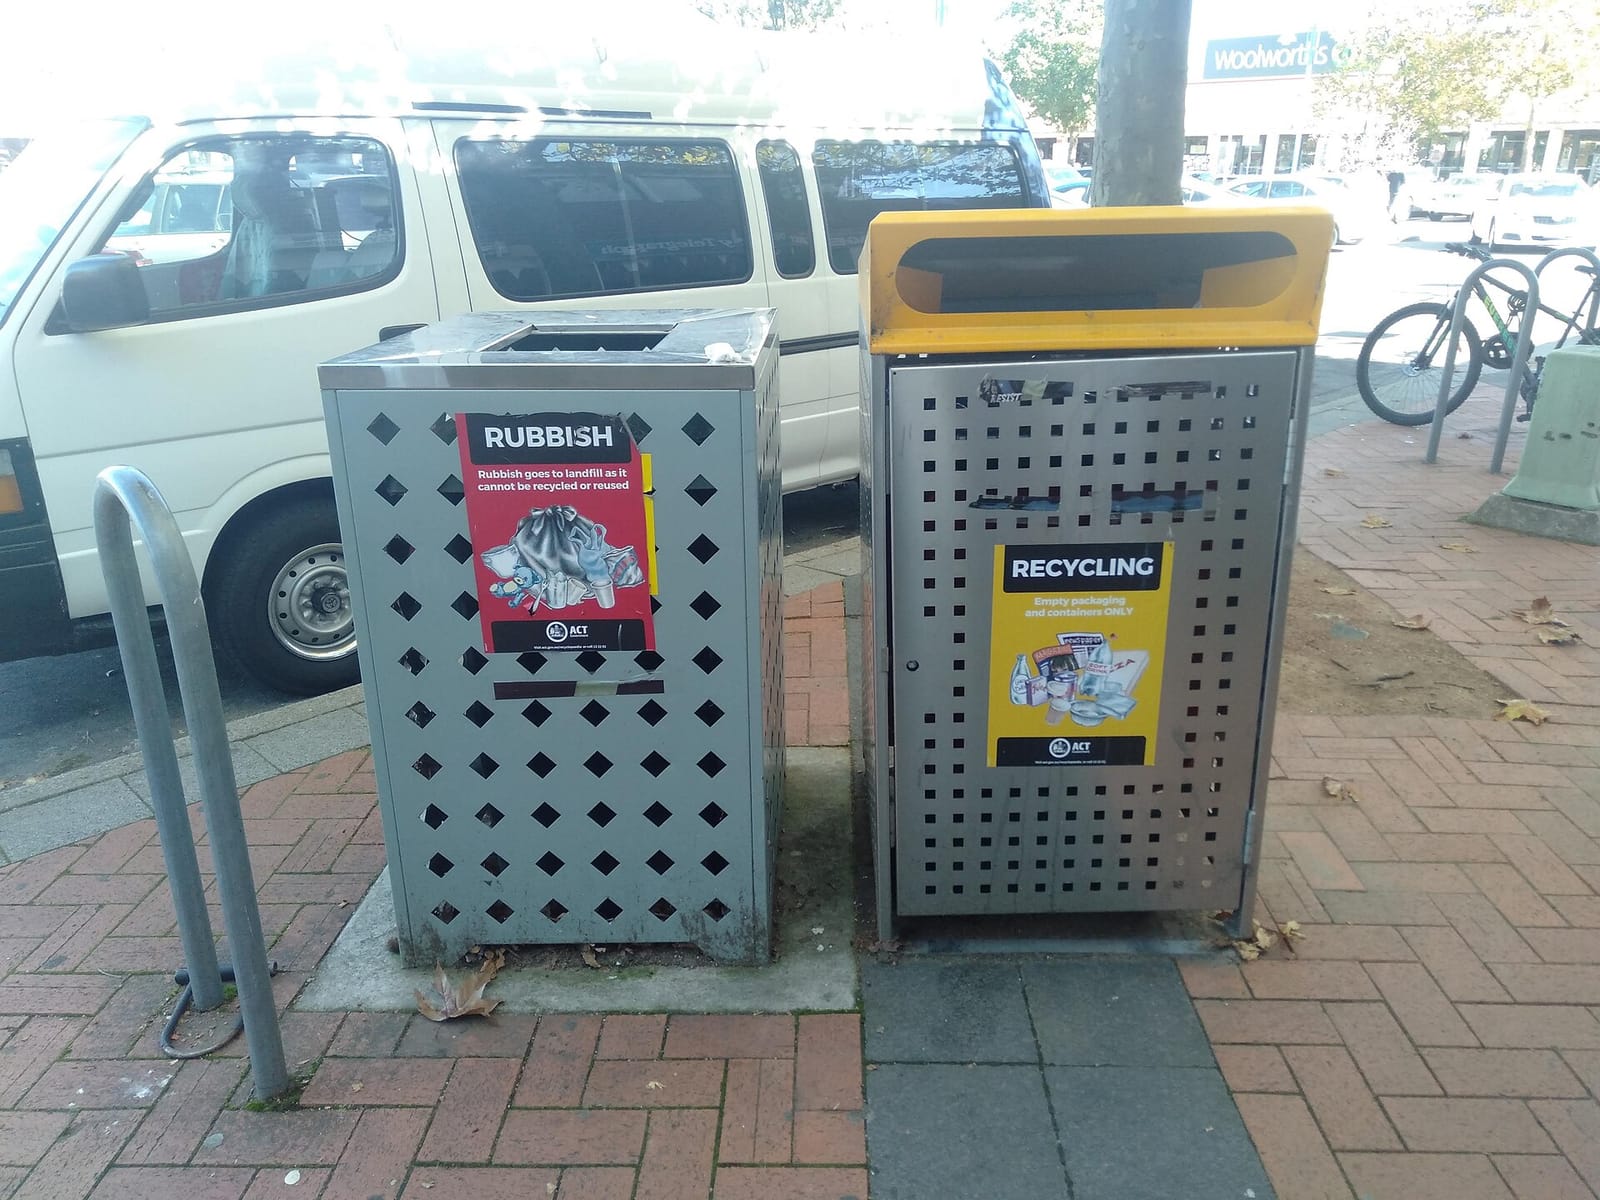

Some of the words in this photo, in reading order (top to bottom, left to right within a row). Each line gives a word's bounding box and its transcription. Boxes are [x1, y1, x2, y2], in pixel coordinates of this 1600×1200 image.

[484, 425, 613, 448] RUBBISH
[478, 469, 523, 479] Rubbish
[525, 470, 550, 481] goes
[551, 470, 564, 479] to
[565, 468, 603, 478] landfill
[605, 470, 617, 478] as
[618, 469, 627, 478] it
[477, 482, 516, 491] cannot
[518, 481, 531, 491] be
[532, 481, 578, 492] recycled
[580, 482, 592, 490] or
[593, 480, 629, 490] reused
[1012, 556, 1154, 578] RECYCLING
[1034, 597, 1069, 607] Empty
[1071, 596, 1126, 607] packaging
[1025, 608, 1045, 617] and
[1047, 607, 1103, 617] containers
[1104, 606, 1134, 616] ONLY
[570, 625, 588, 634] ACT
[1072, 742, 1091, 751] ACT
